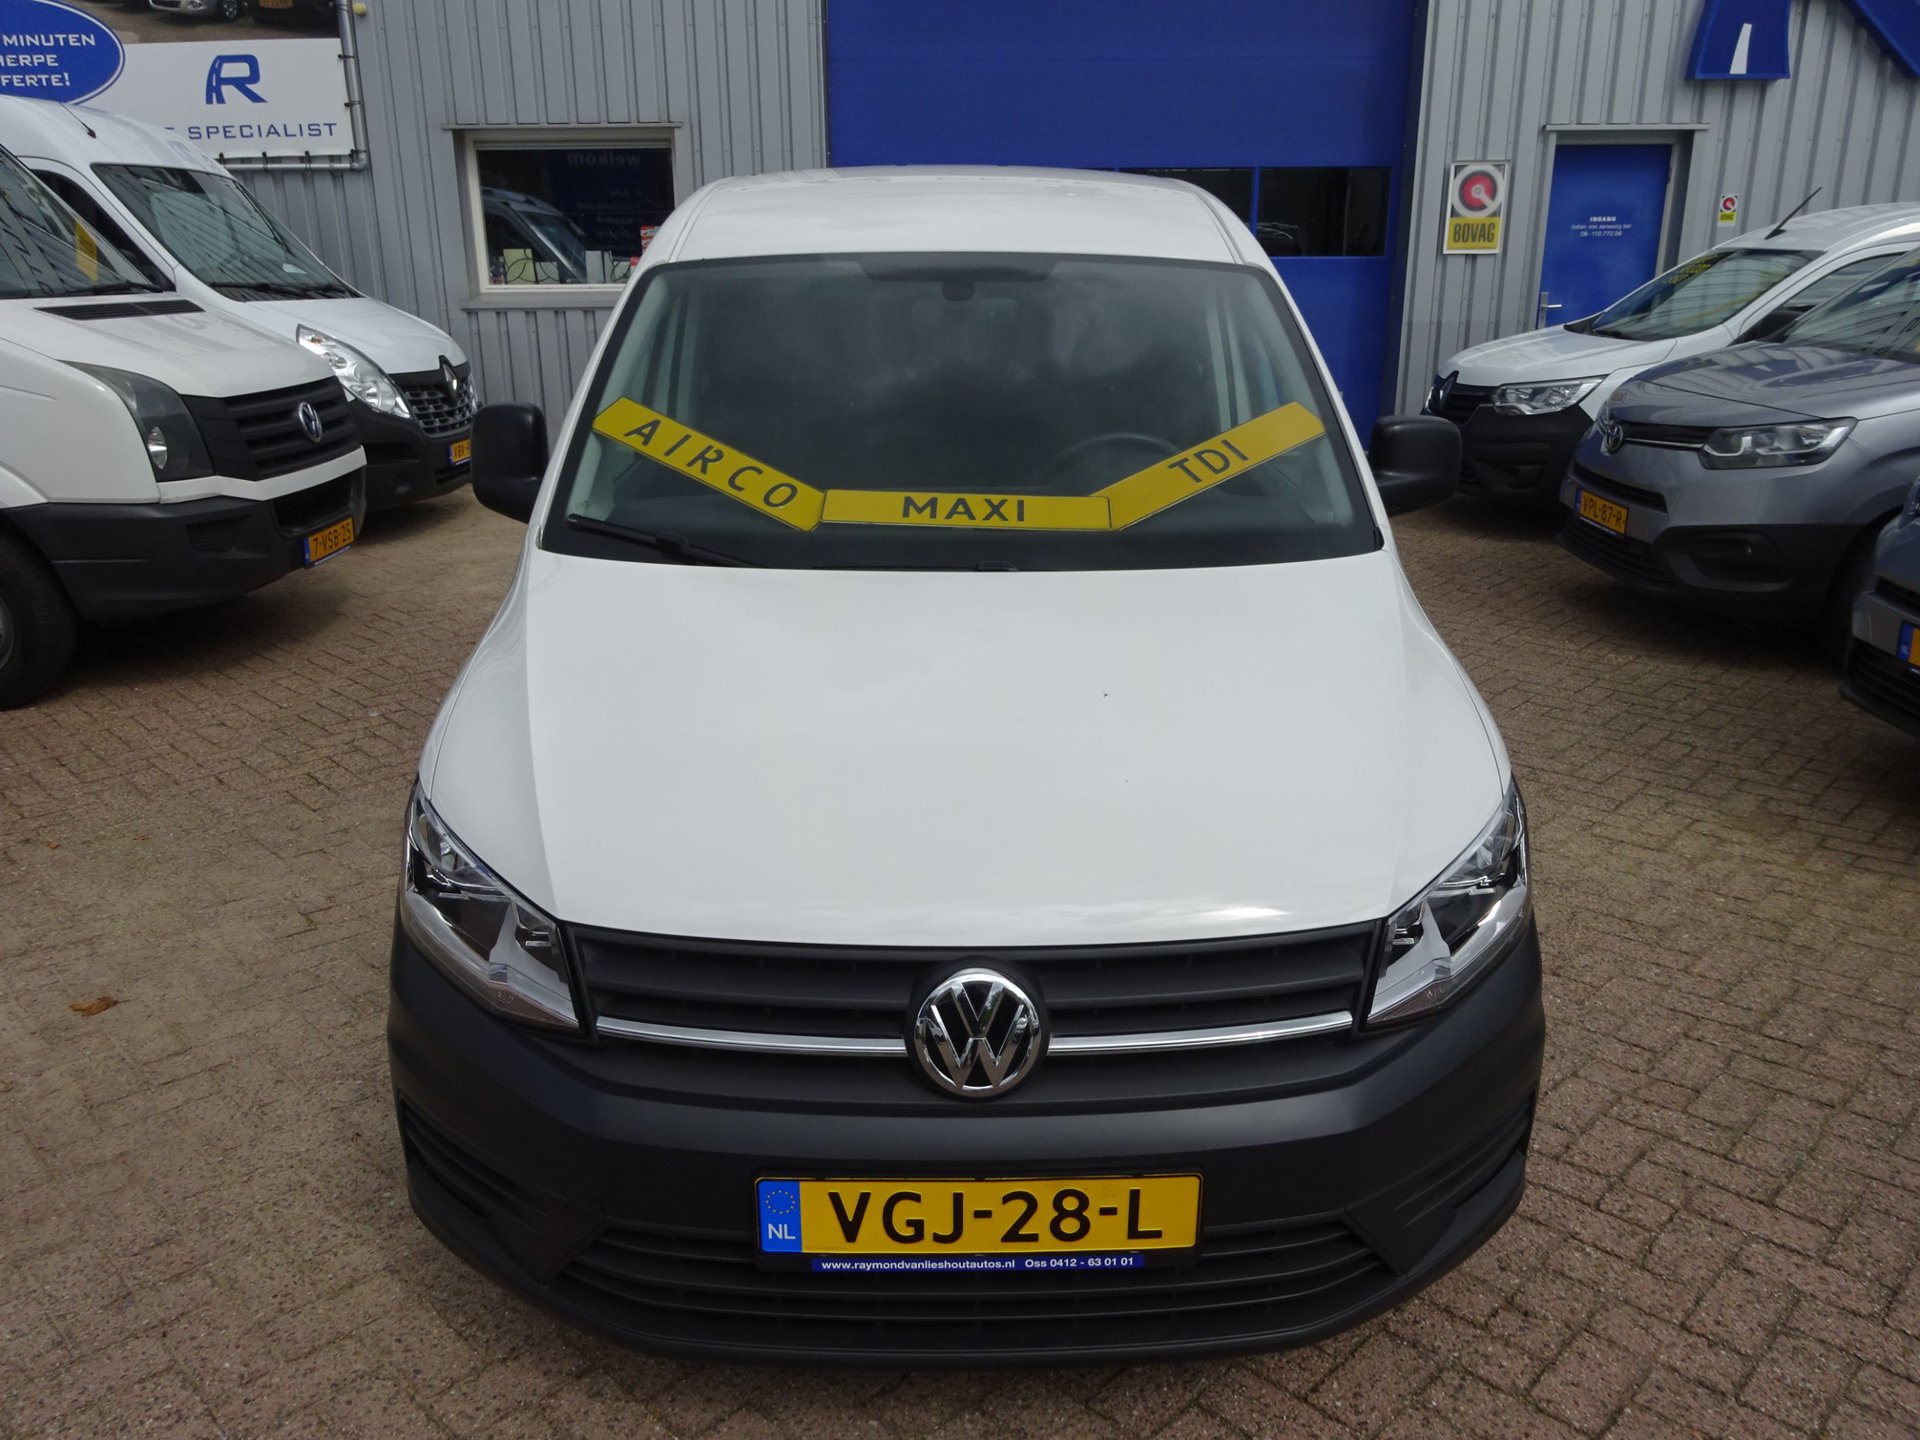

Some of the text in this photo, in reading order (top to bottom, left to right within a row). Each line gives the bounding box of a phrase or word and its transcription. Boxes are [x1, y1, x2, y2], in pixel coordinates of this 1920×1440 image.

[2, 33, 96, 46] MINUTEN
[0, 72, 71, 87] FERTE!
[188, 123, 337, 140] SPECIALIST
[1453, 222, 1496, 243] BOVAG
[624, 409, 799, 508] AIRCO
[1168, 439, 1250, 484] TDI
[902, 496, 1026, 522] MAXI
[767, 1188, 1163, 1244] NL VGJ-28-L
[821, 1259, 1015, 1271] www.raymondvanlieshoutautos.nl
[1024, 1258, 1047, 1268] Oss
[1050, 1258, 1077, 1267] 0412
[1088, 1258, 1101, 1267] 63
[1105, 1258, 1117, 1266] 01
[1121, 1257, 1133, 1266] 01
